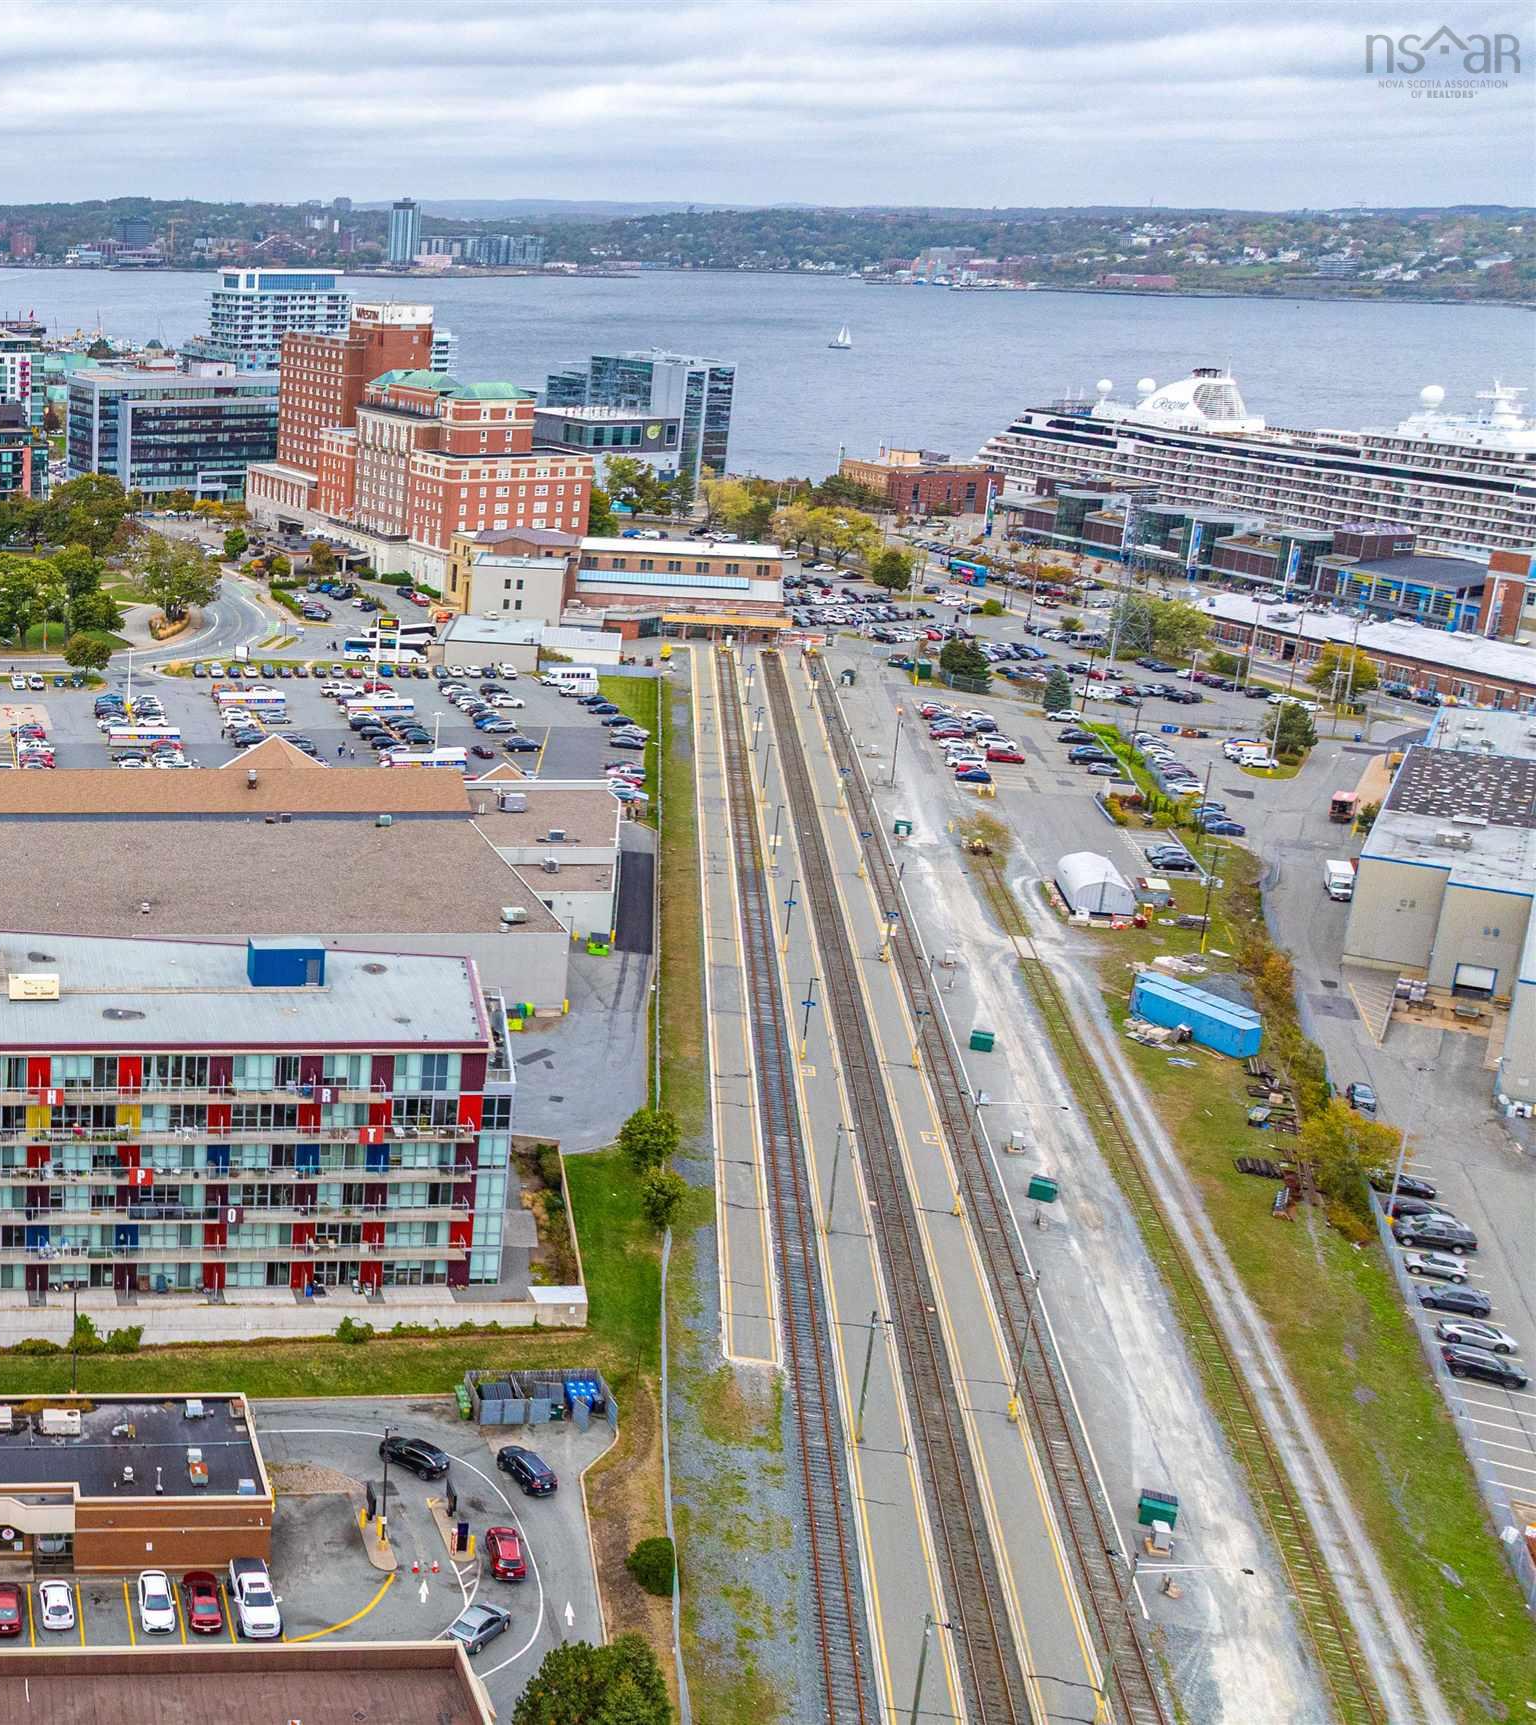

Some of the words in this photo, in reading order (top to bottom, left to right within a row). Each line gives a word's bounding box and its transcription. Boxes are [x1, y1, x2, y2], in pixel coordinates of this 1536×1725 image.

[47, 1089, 56, 1105] H
[137, 1169, 146, 1184] P
[227, 1208, 236, 1223] O
[322, 1088, 331, 1103] R
[366, 1128, 376, 1143] T
